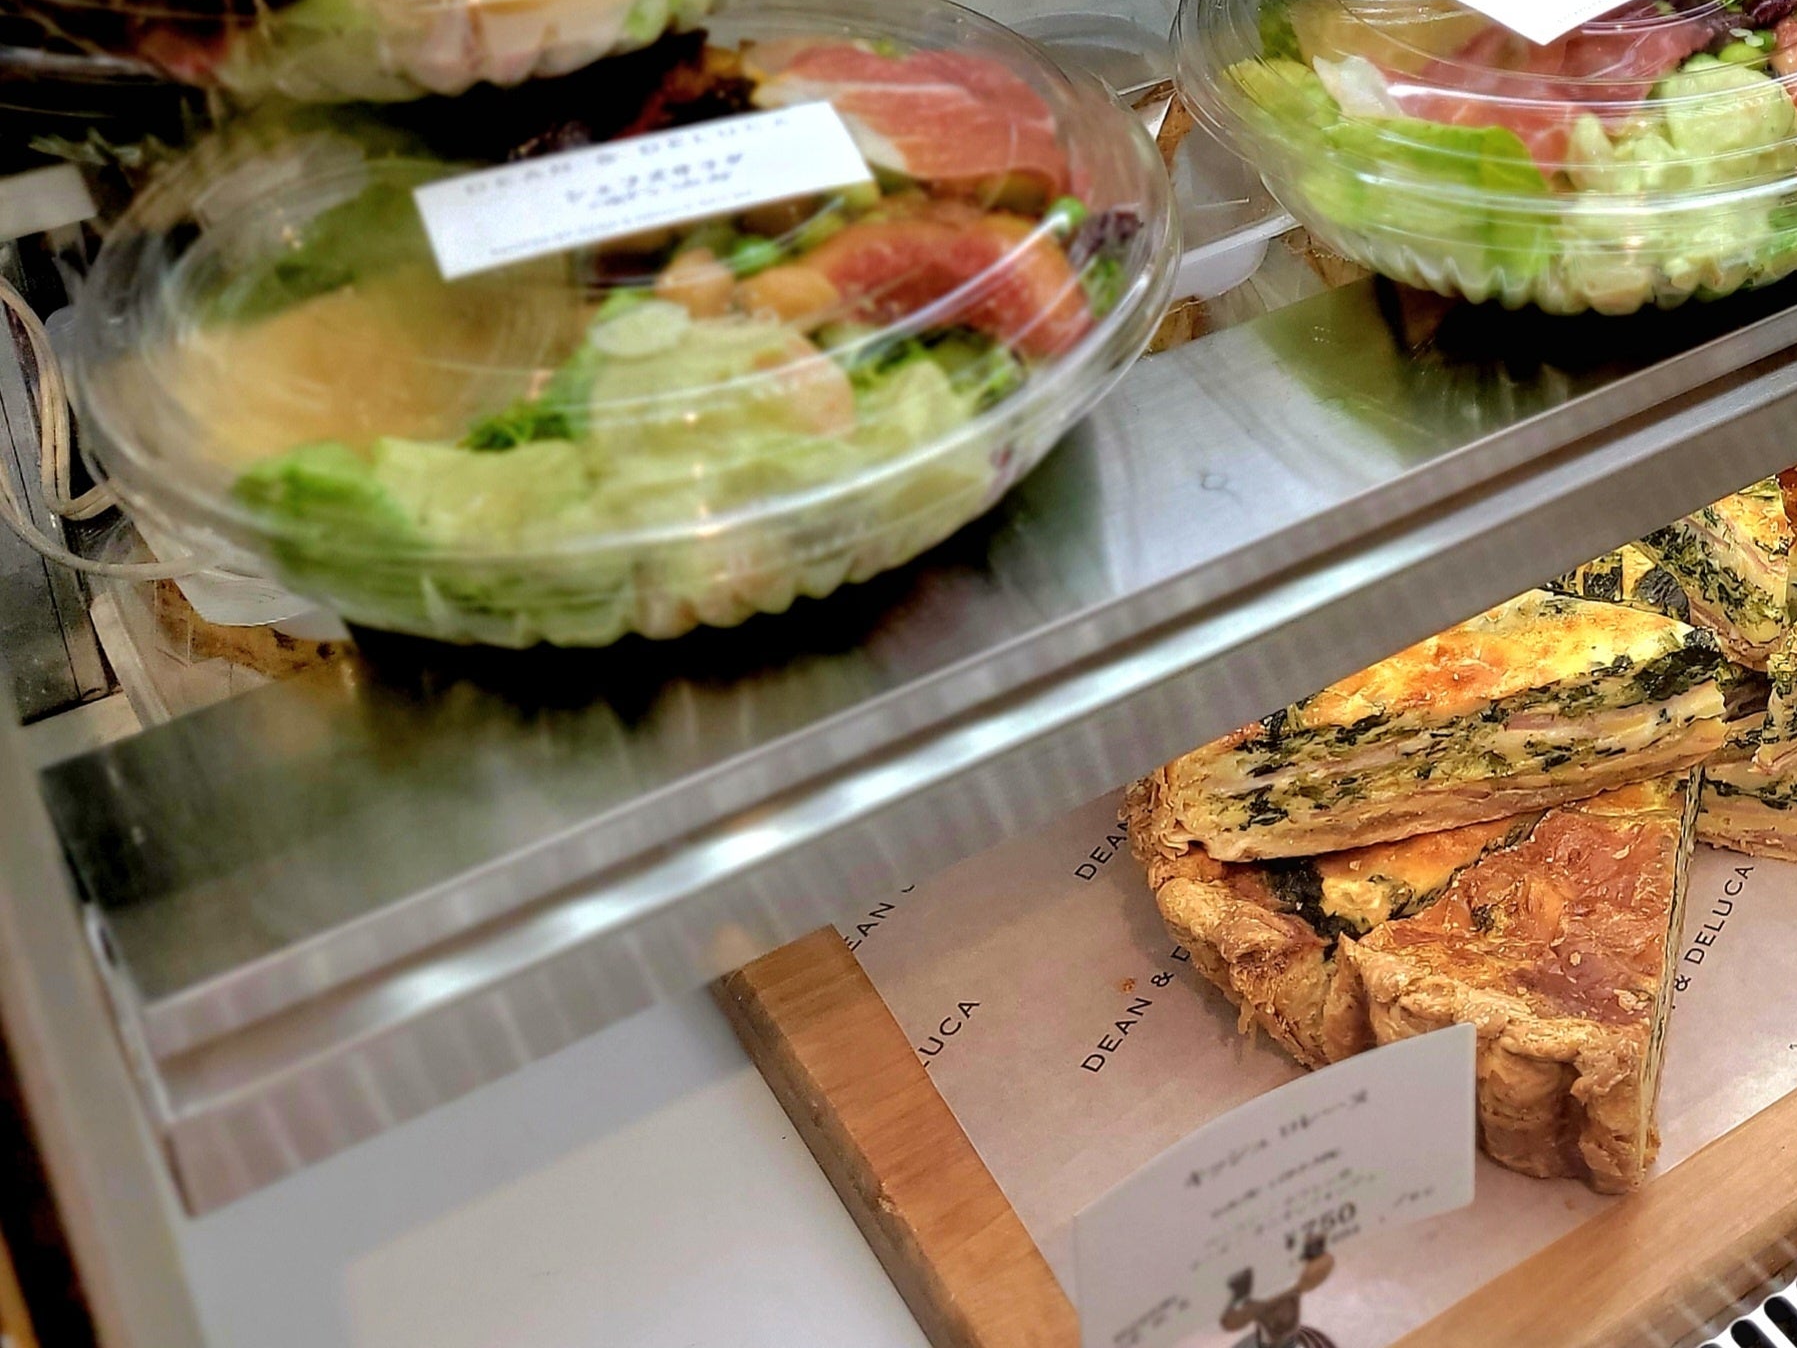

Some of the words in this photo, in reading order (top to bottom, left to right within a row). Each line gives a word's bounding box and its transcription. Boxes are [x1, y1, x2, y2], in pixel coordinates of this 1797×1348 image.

[844, 902, 896, 953] EAN
[1672, 973, 1692, 993] &
[1683, 863, 1756, 966] DELUCA
[918, 1001, 981, 1068] UCA
[1080, 996, 1153, 1074] DEAN
[1150, 971, 1175, 988] &
